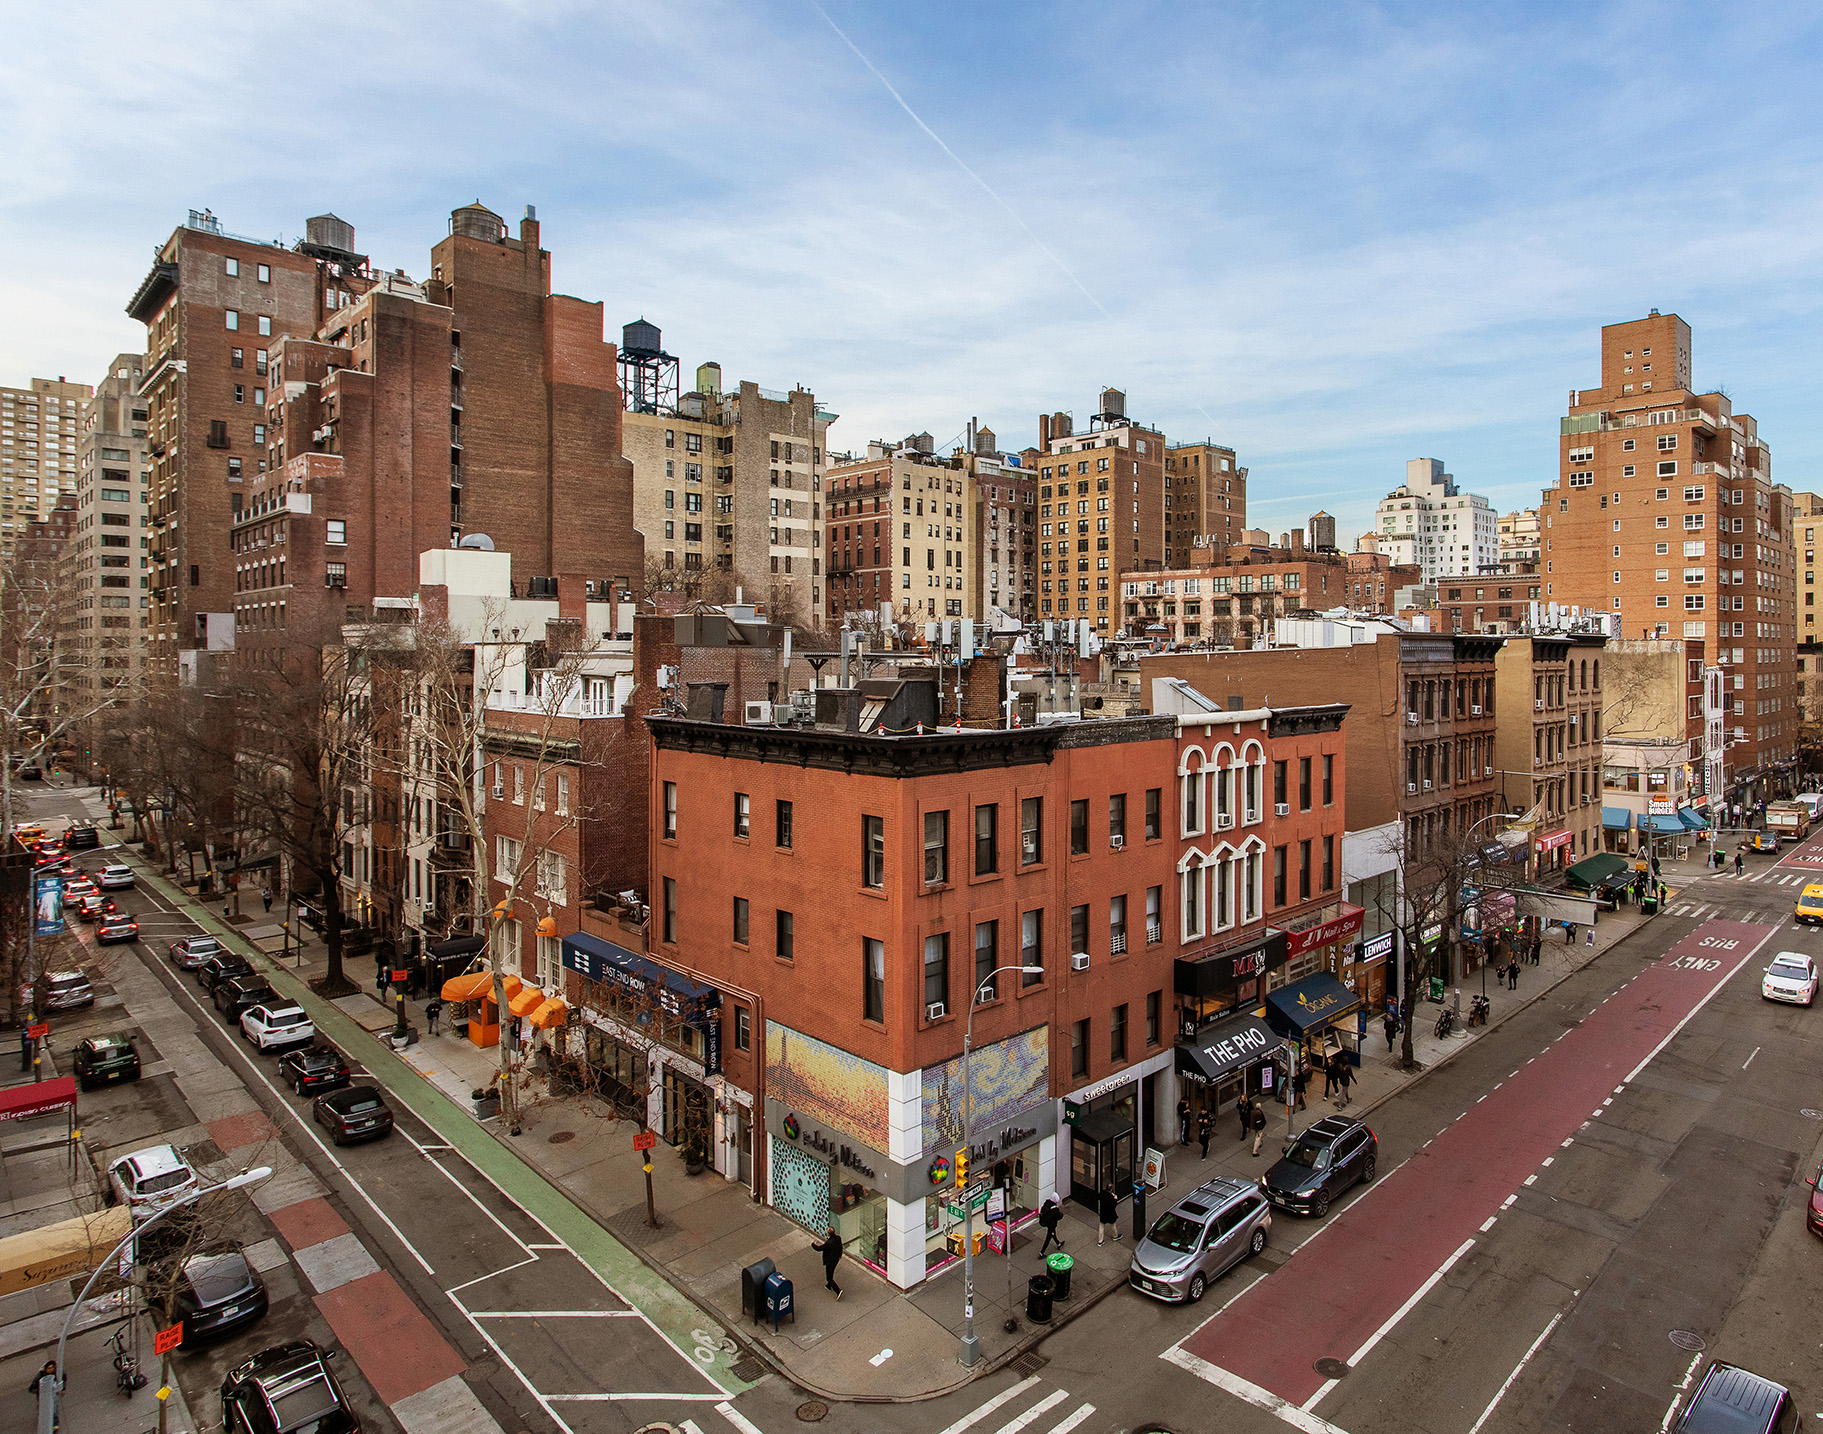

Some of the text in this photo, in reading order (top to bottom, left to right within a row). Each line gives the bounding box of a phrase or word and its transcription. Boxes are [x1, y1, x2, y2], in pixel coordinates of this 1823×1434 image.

[1648, 807, 1674, 815] BURGER
[1323, 926, 1338, 939] Nail
[1342, 921, 1355, 933] Spa
[1364, 937, 1392, 959] LENWICH
[1698, 936, 1740, 950] BUS
[1232, 952, 1256, 978] MK
[1342, 952, 1355, 967] Nail
[1668, 955, 1722, 972] ONLY
[602, 963, 616, 979] EAST
[616, 969, 629, 985] END
[629, 975, 645, 991] ROW
[1344, 978, 1355, 990] Spa
[1203, 1039, 1240, 1066] THE
[1231, 1027, 1267, 1055] PHO
[1182, 1069, 1193, 1079] THE
[1193, 1073, 1207, 1084] PHO
[1084, 1074, 1132, 1101] sweetgreen
[1066, 1110, 1075, 1119] sg
[160, 1326, 181, 1341] RAISE
[160, 1337, 179, 1351] PLOW
